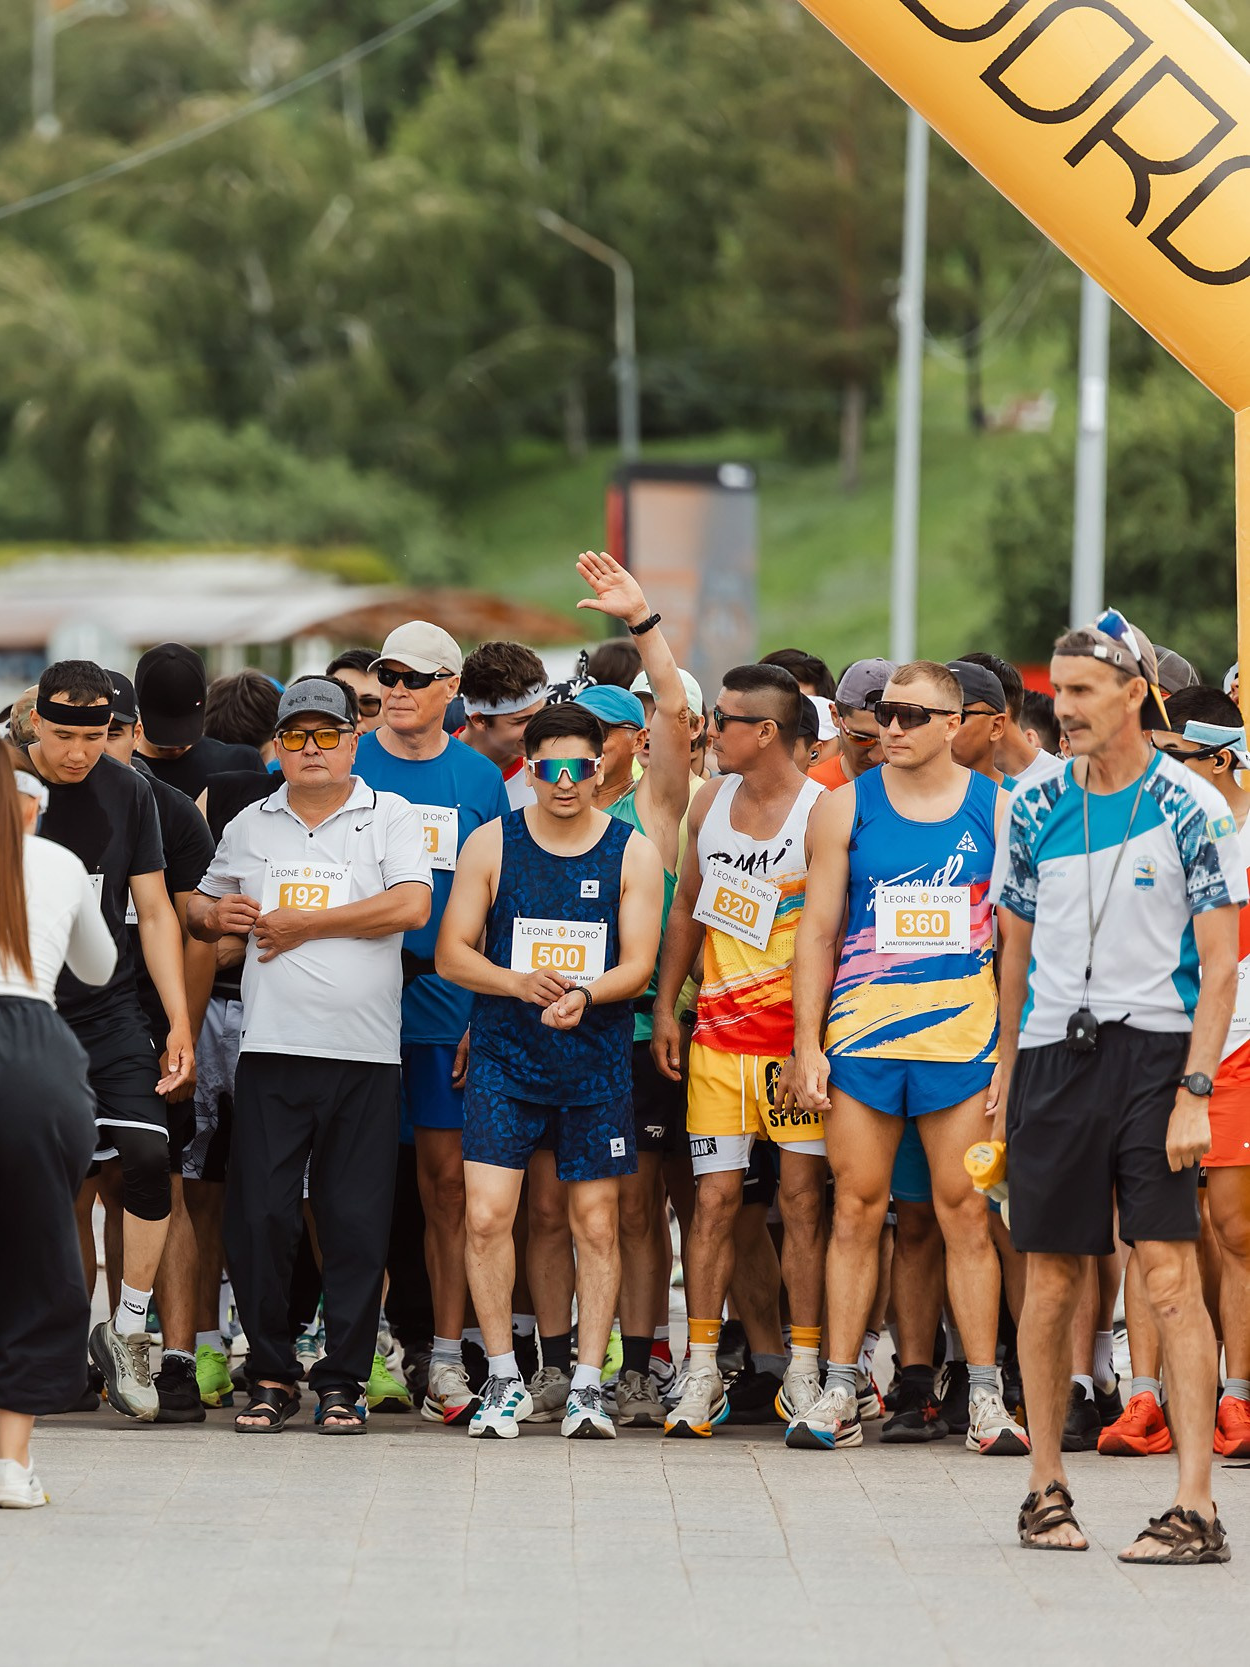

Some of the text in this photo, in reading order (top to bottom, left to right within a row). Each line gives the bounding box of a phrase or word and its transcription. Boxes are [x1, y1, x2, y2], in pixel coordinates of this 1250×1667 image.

[271, 869, 343, 881] LEONE D'ORO
[712, 868, 739, 886] LEONE
[284, 885, 324, 907] 192
[884, 895, 962, 904] LEONE D'ORO
[718, 891, 754, 923] 320
[521, 927, 599, 939] LEONE D'ORO
[901, 913, 945, 934] 360
[537, 946, 580, 968] 500
